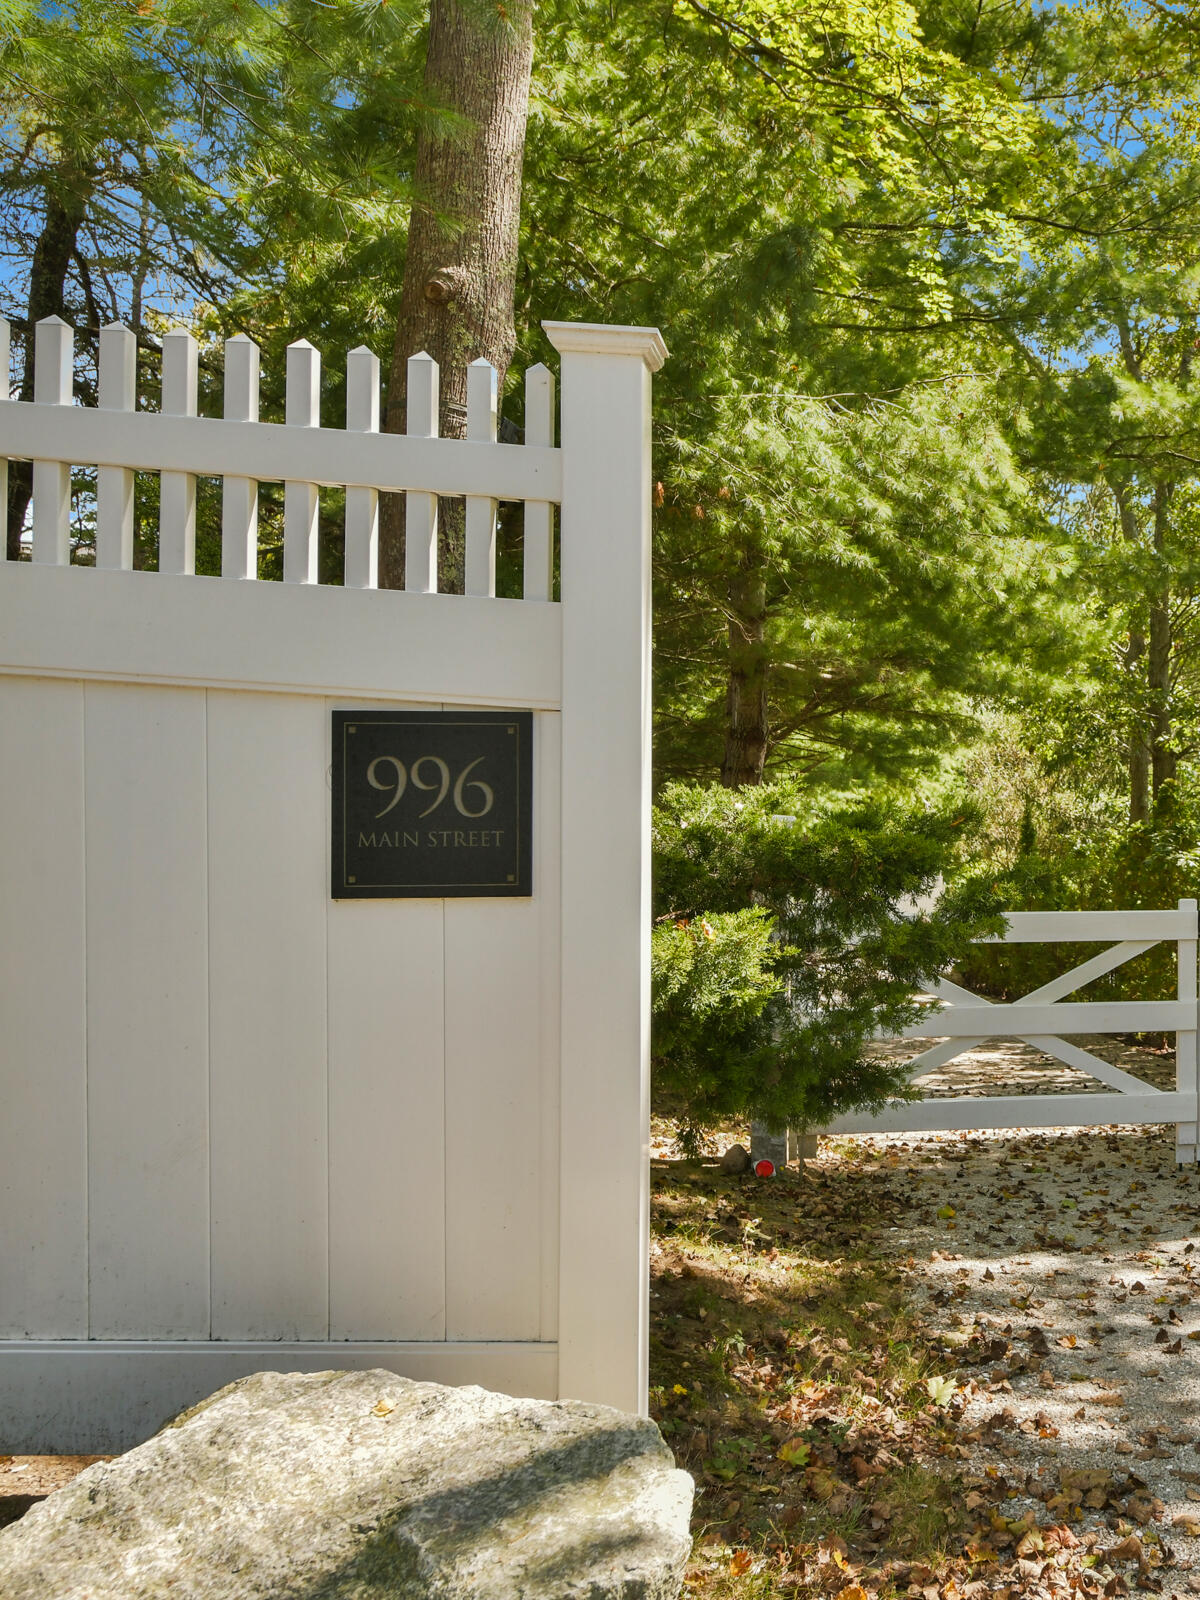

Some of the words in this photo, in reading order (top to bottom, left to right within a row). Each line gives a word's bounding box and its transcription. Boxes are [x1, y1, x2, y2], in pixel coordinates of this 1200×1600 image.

[366, 756, 494, 819] 996
[358, 831, 419, 848] MAIN
[428, 830, 504, 847] STREET
